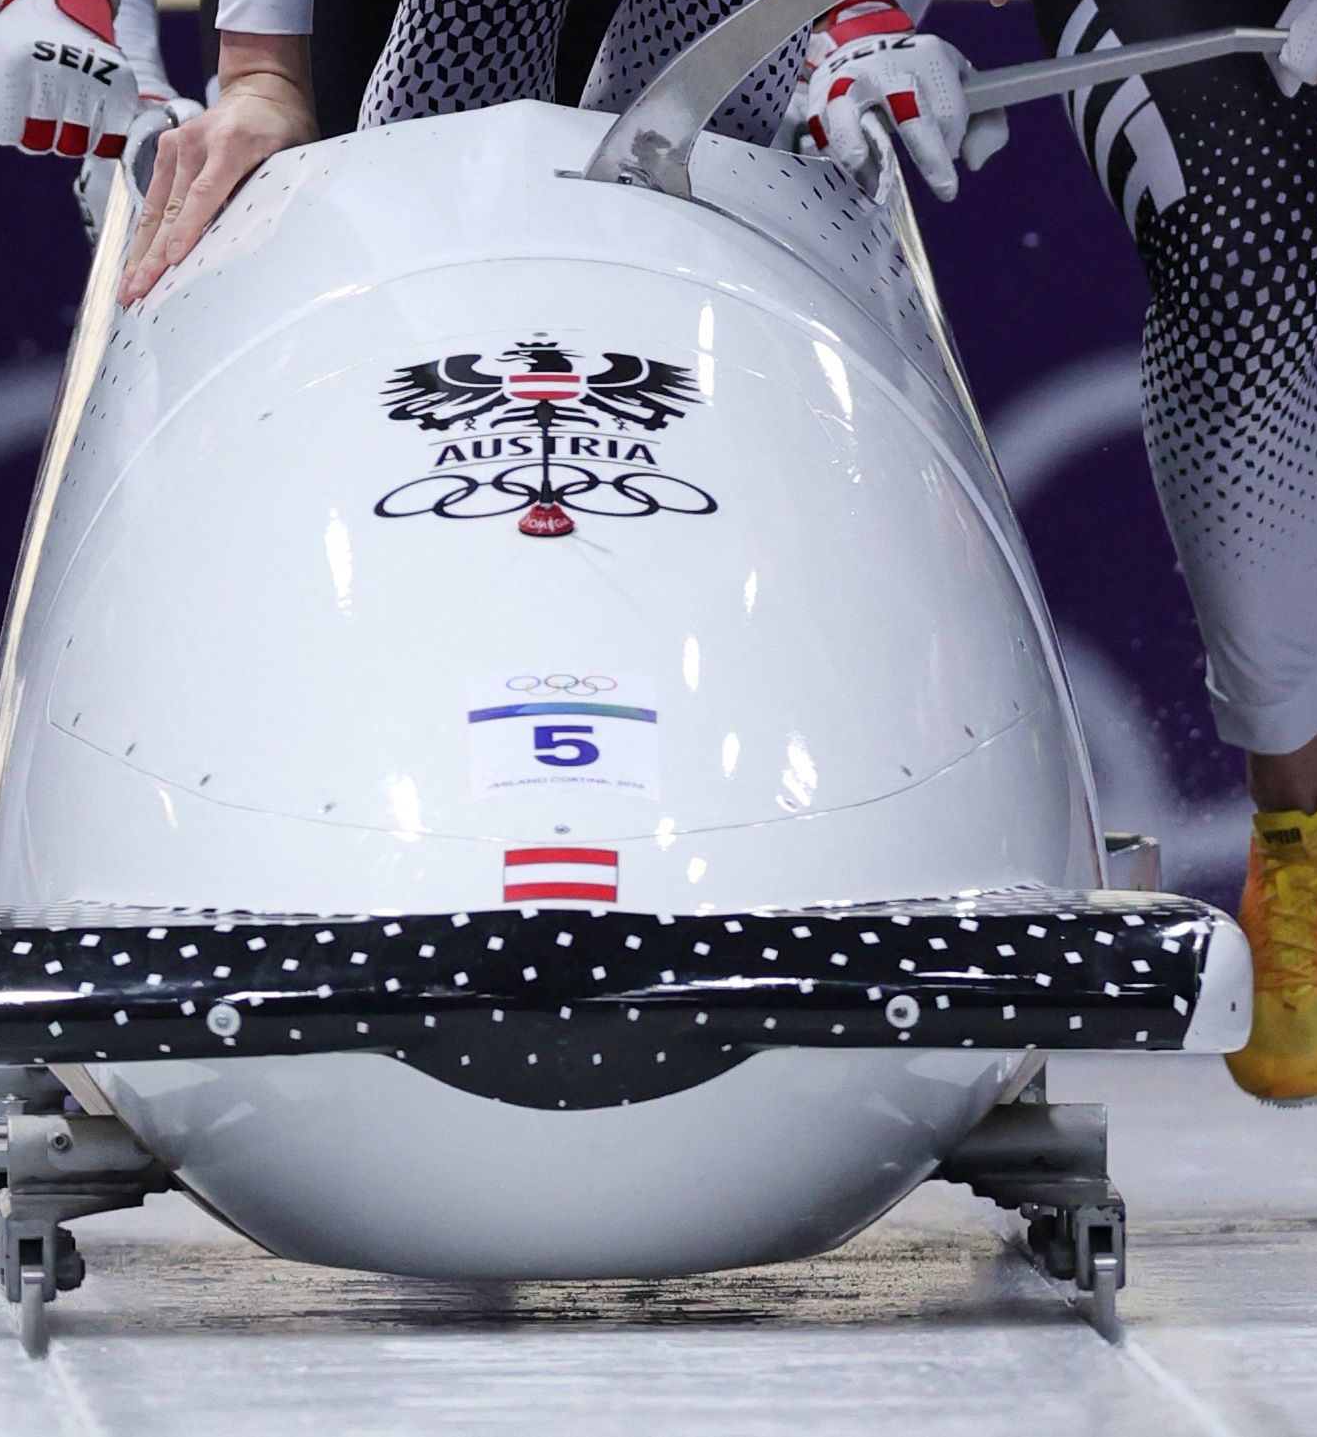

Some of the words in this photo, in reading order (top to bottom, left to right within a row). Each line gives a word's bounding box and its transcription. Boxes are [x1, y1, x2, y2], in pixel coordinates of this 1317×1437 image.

[434, 435, 658, 467] AUSTRIA
[534, 725, 600, 767] 5
[488, 776, 548, 790] MILANO
[549, 775, 613, 786] CORTINA
[615, 779, 646, 790] 2026
